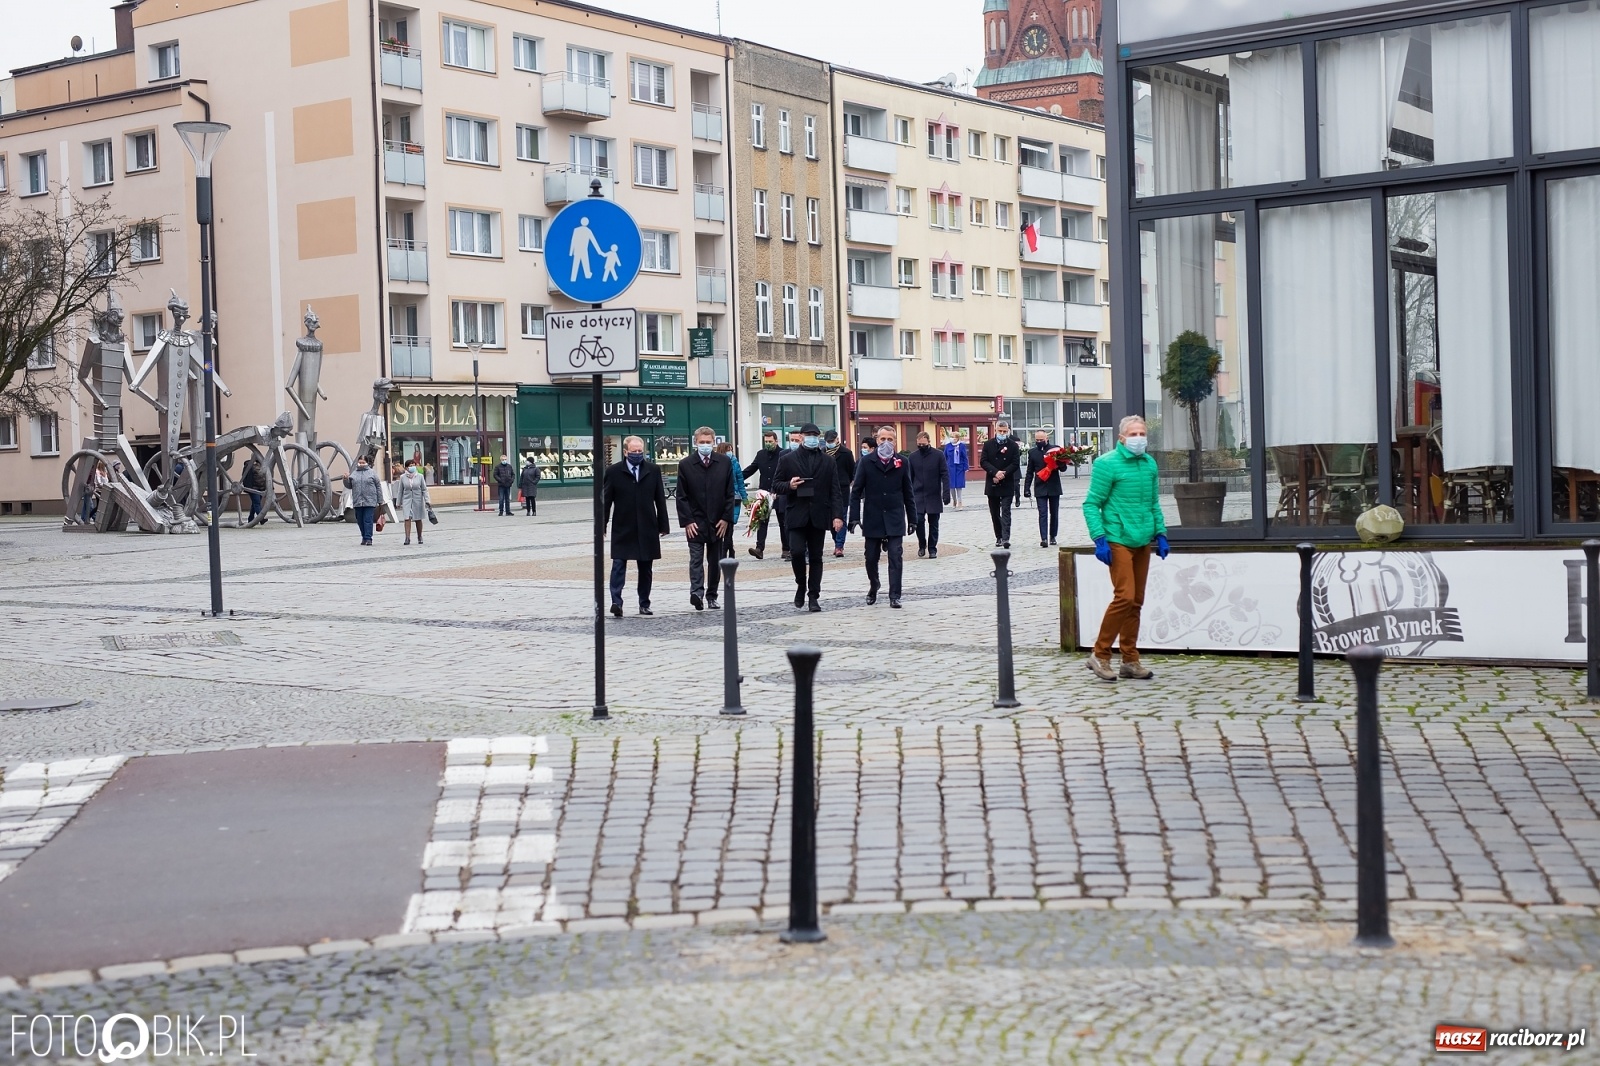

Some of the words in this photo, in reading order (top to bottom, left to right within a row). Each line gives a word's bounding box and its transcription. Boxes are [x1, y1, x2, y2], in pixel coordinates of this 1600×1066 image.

[551, 315, 574, 330] Nie
[580, 314, 633, 331] dotyczy
[393, 398, 477, 426] STELLA
[603, 402, 665, 417] UBILER
[1079, 407, 1097, 420] empik
[1315, 624, 1381, 653] Browar
[1383, 610, 1444, 644] Rynek
